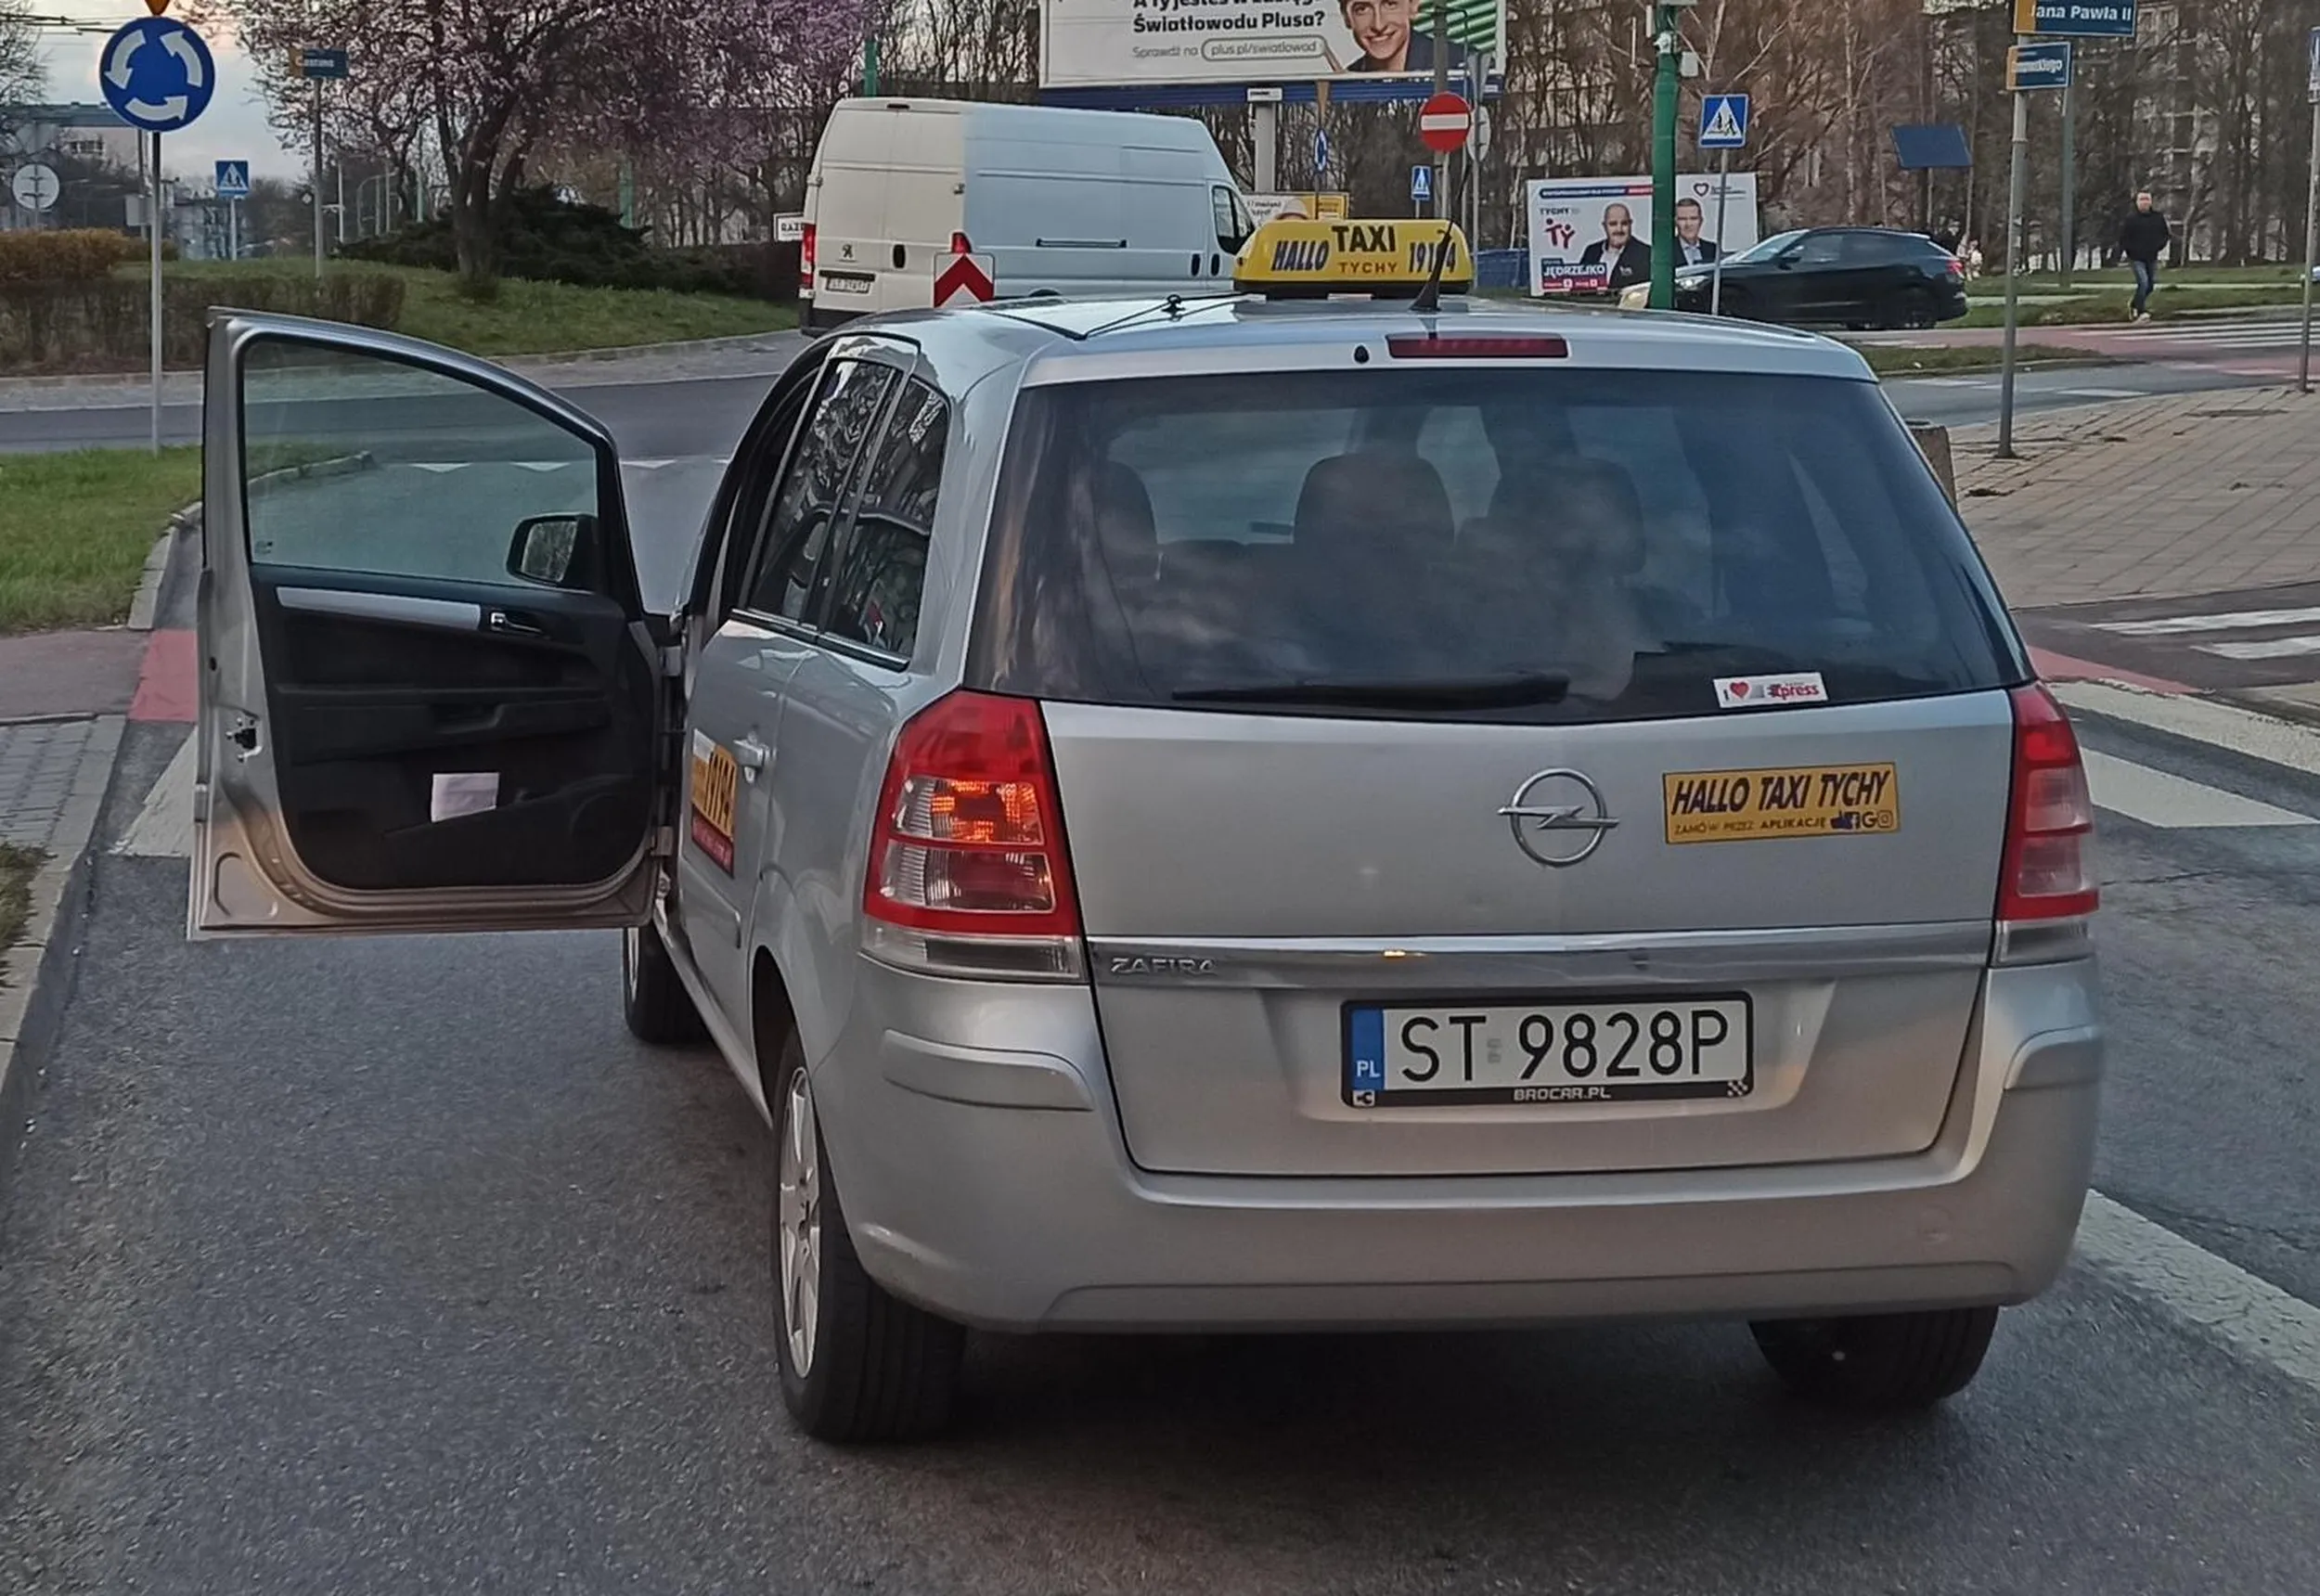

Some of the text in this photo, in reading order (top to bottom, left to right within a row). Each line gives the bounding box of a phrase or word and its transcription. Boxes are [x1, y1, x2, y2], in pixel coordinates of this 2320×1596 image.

[1133, 10, 1325, 33] Światłowodu Plusa?
[1183, 46, 1198, 56] na
[1271, 238, 1330, 272] HALLO
[1332, 225, 1396, 253] TAXI
[1339, 261, 1398, 275] TYCHY
[1544, 264, 1605, 278] JĘDRZEJKO
[1671, 769, 1890, 816] HALLO TAXI TYCHY
[1111, 957, 1217, 974] ZAFIRA
[1400, 1010, 1729, 1083] ST 9828P
[1357, 1060, 1382, 1078] PL
[1513, 1087, 1611, 1102] BROCAR.PL
